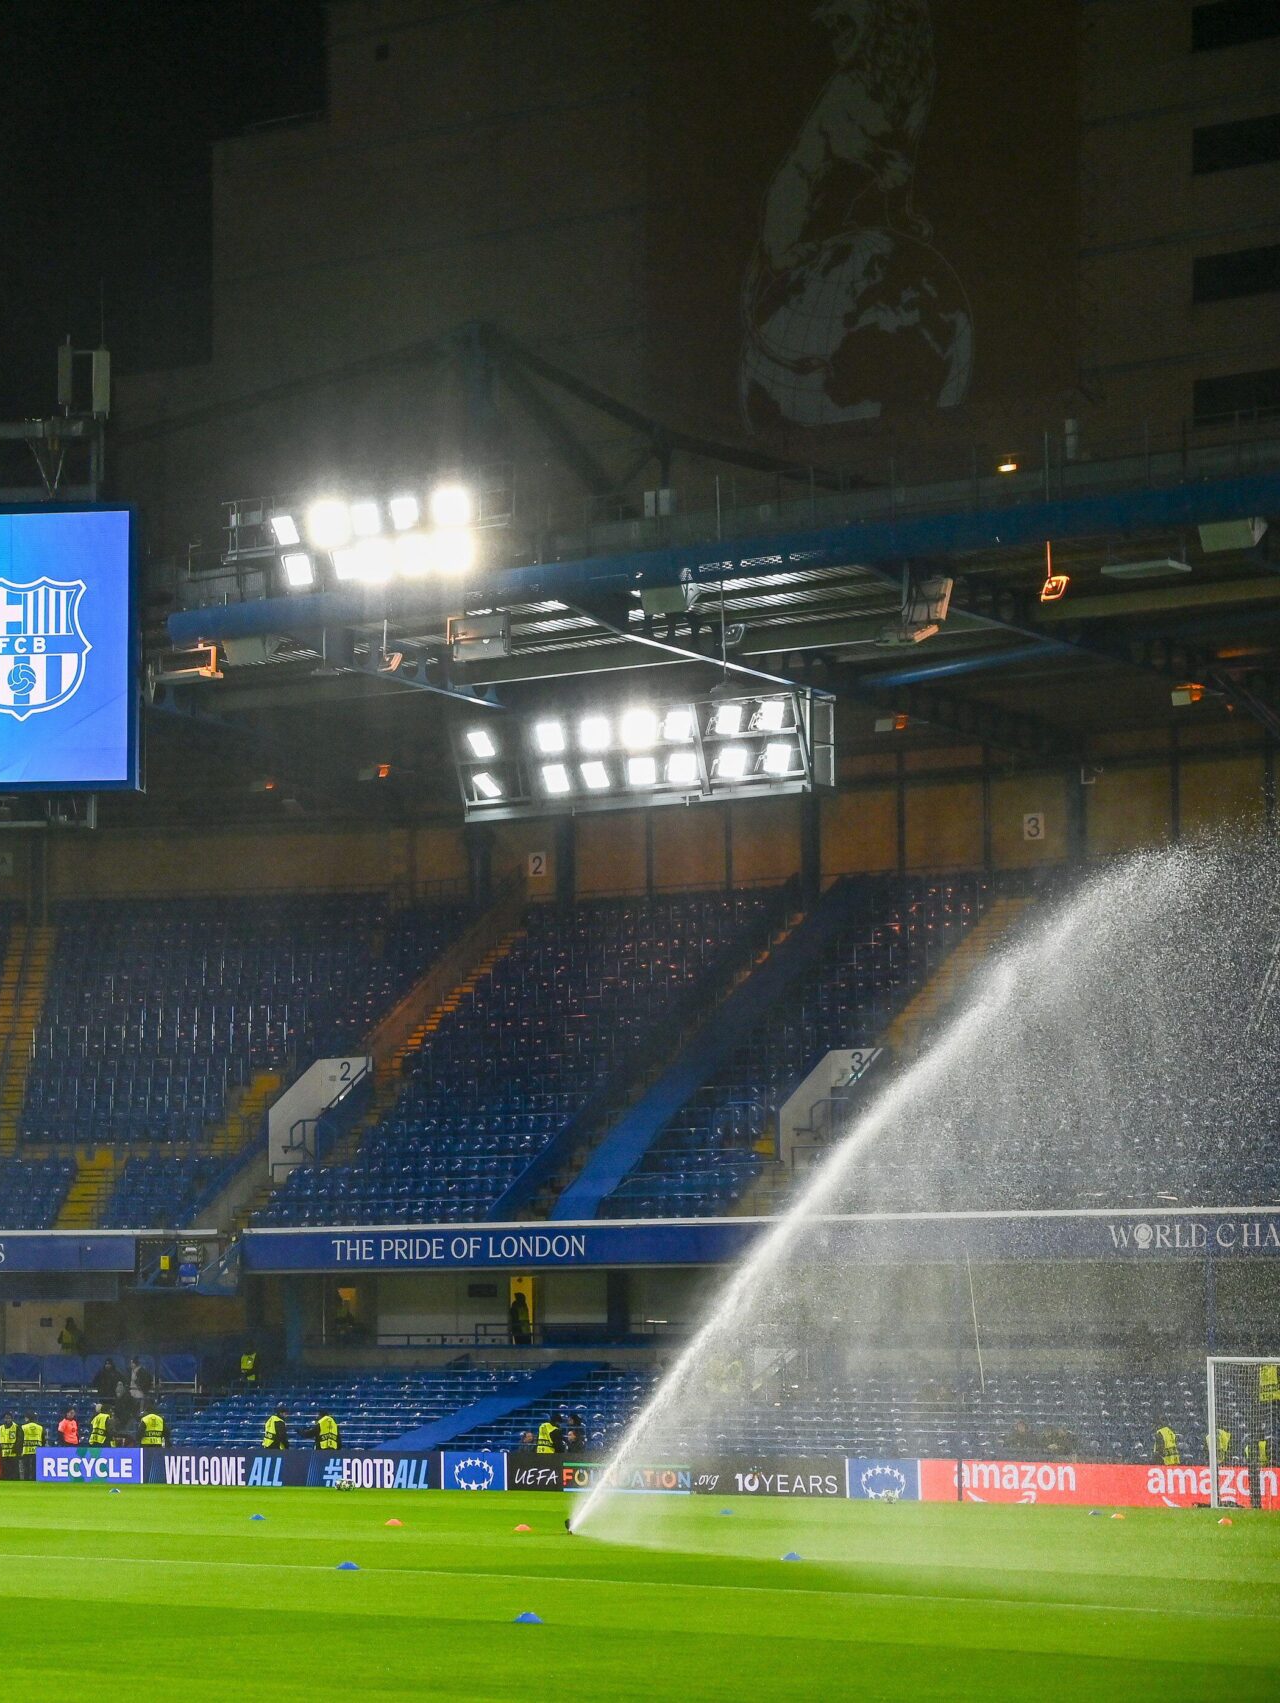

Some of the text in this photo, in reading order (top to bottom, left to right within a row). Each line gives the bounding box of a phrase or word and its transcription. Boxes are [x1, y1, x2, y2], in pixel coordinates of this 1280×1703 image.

[1027, 816, 1040, 838] 3
[532, 855, 543, 875] 2
[340, 1061, 351, 1081] 2
[851, 1051, 864, 1073] 3
[331, 1234, 586, 1261] THE PRIDE OF LONDON
[1107, 1223, 1208, 1249] WORLD
[43, 1457, 133, 1477] RECYCLE
[164, 1455, 283, 1487] WELCOME ALL
[323, 1458, 429, 1489] #FOOTBALL
[953, 1462, 1076, 1490] amazon
[514, 1467, 559, 1485] UEFA
[694, 1473, 720, 1491] .org
[758, 1475, 838, 1494] YEARS
